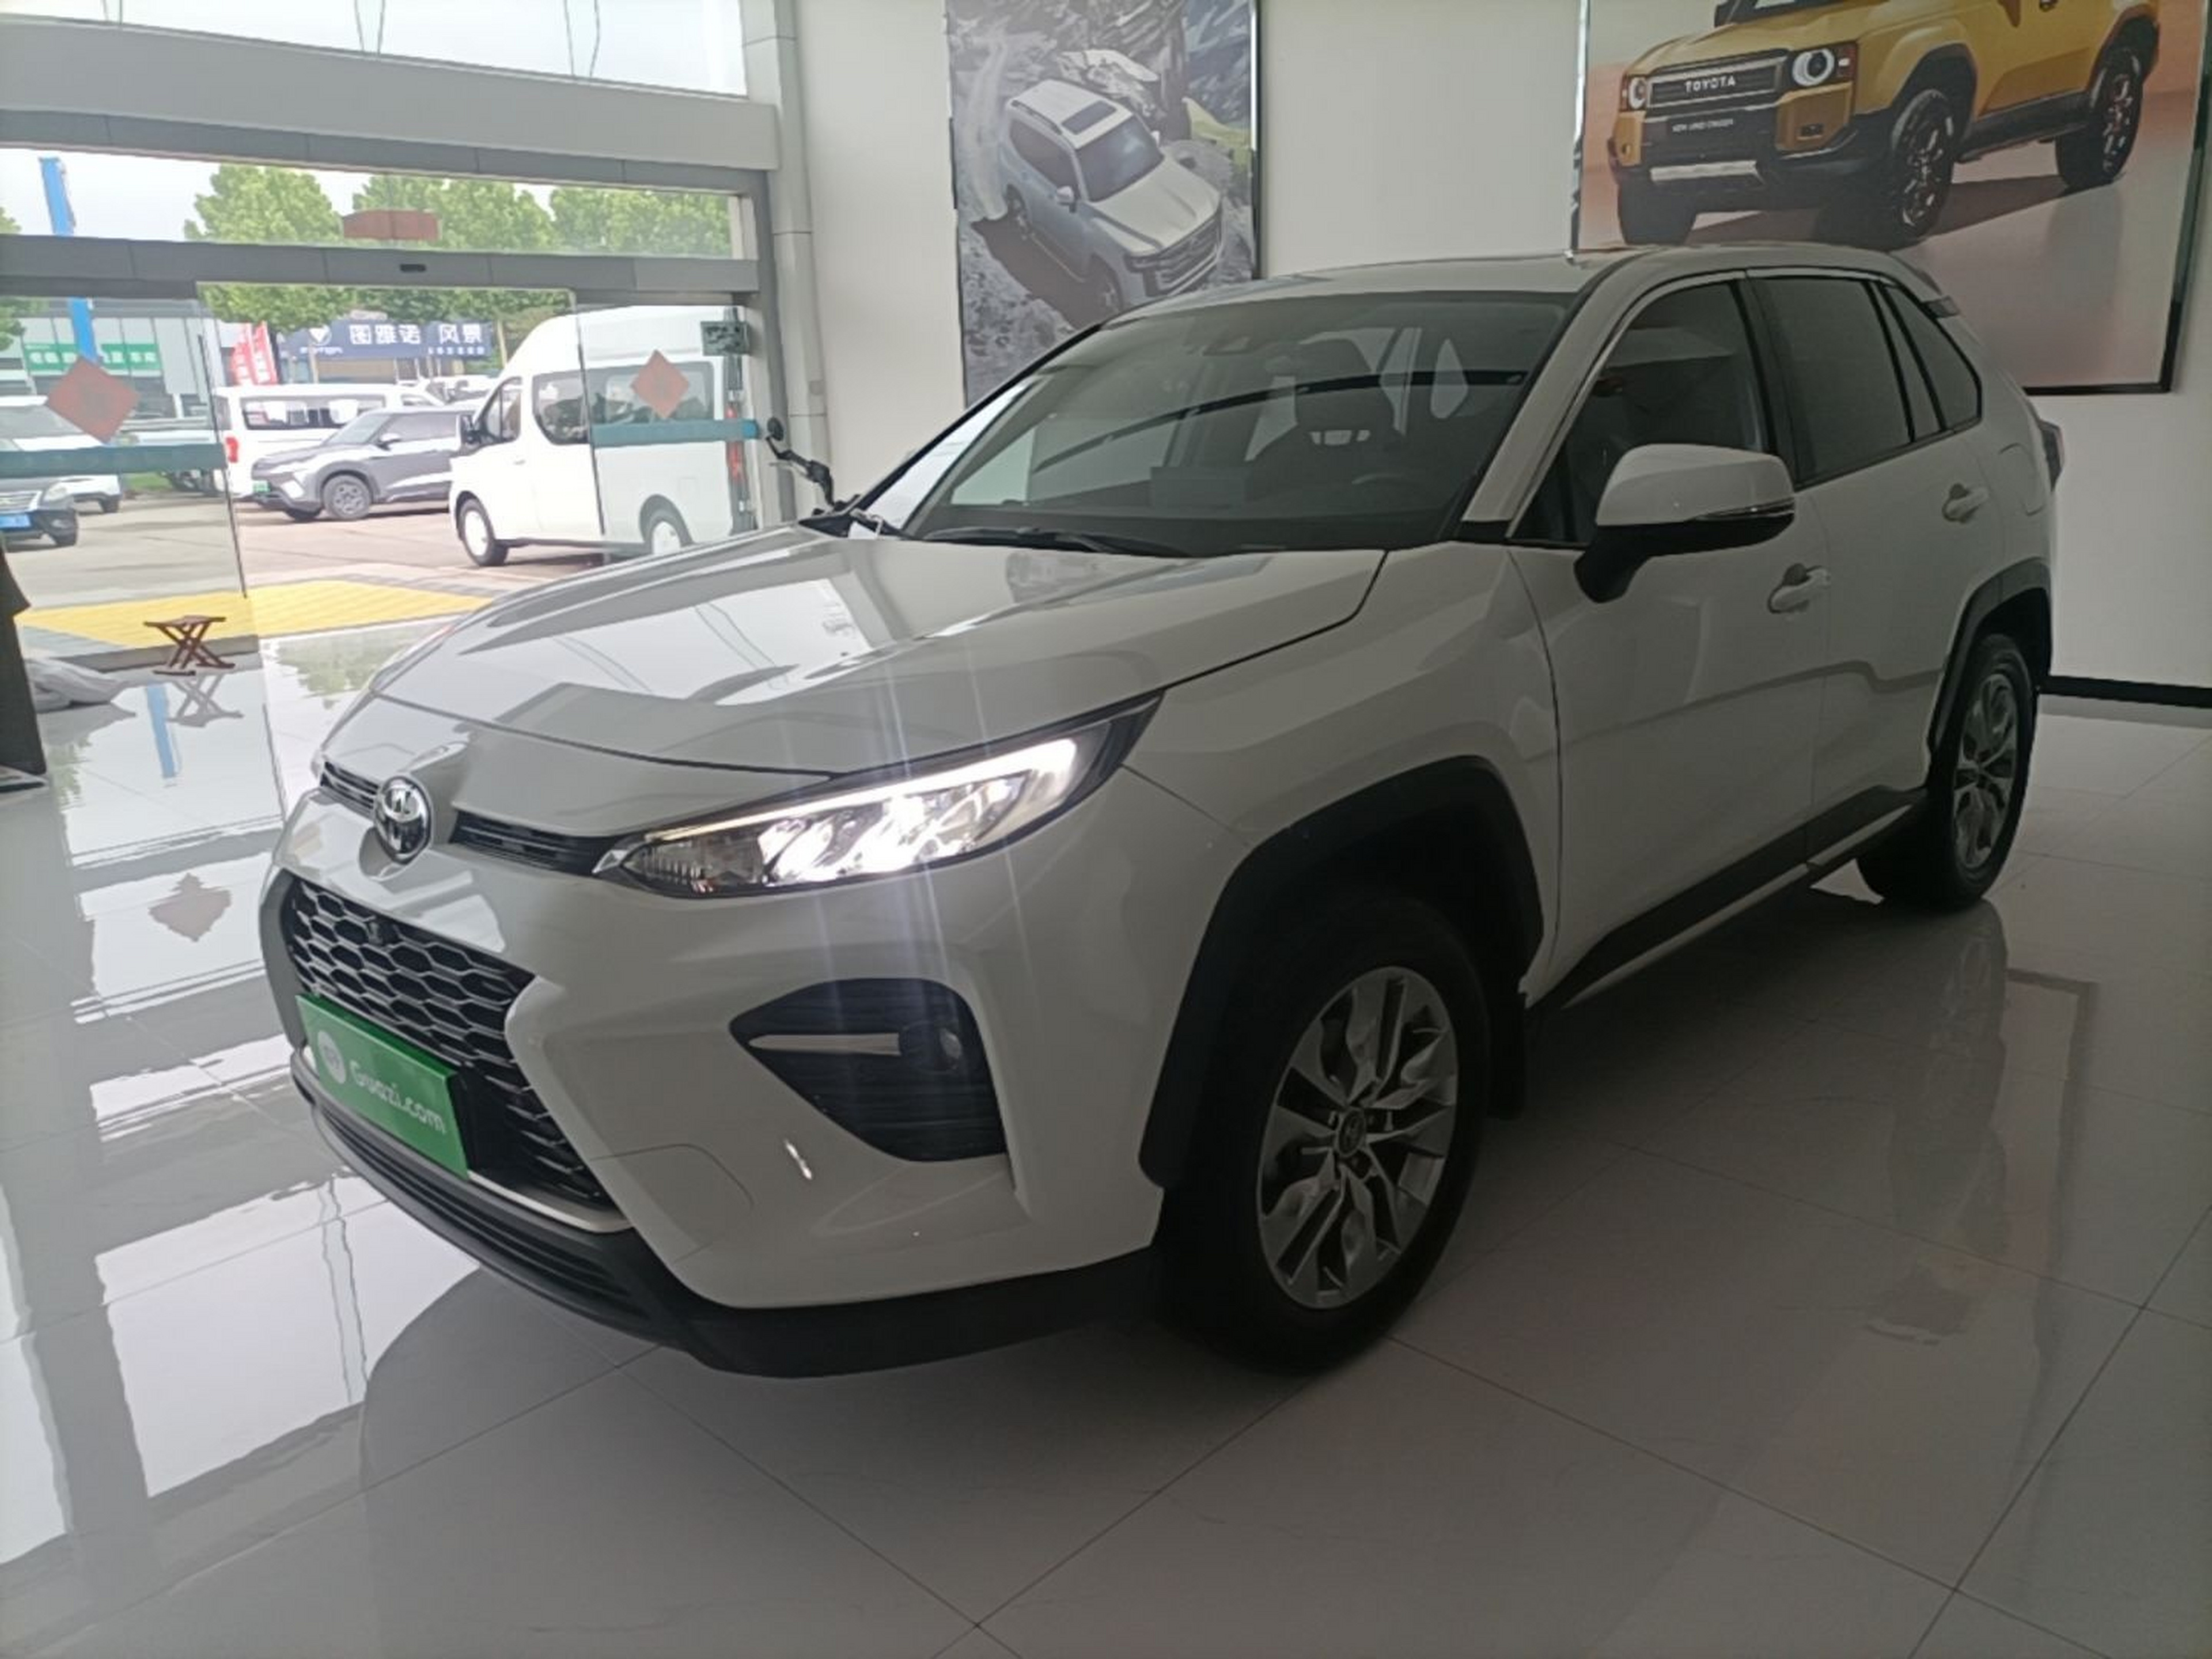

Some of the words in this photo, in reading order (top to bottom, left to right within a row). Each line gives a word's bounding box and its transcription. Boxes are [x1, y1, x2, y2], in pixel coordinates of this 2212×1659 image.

[1684, 75, 1736, 93] TOYOTA
[349, 324, 421, 344] 图雅诺
[438, 323, 482, 344] 风景
[349, 1060, 446, 1134] Guazi.com
